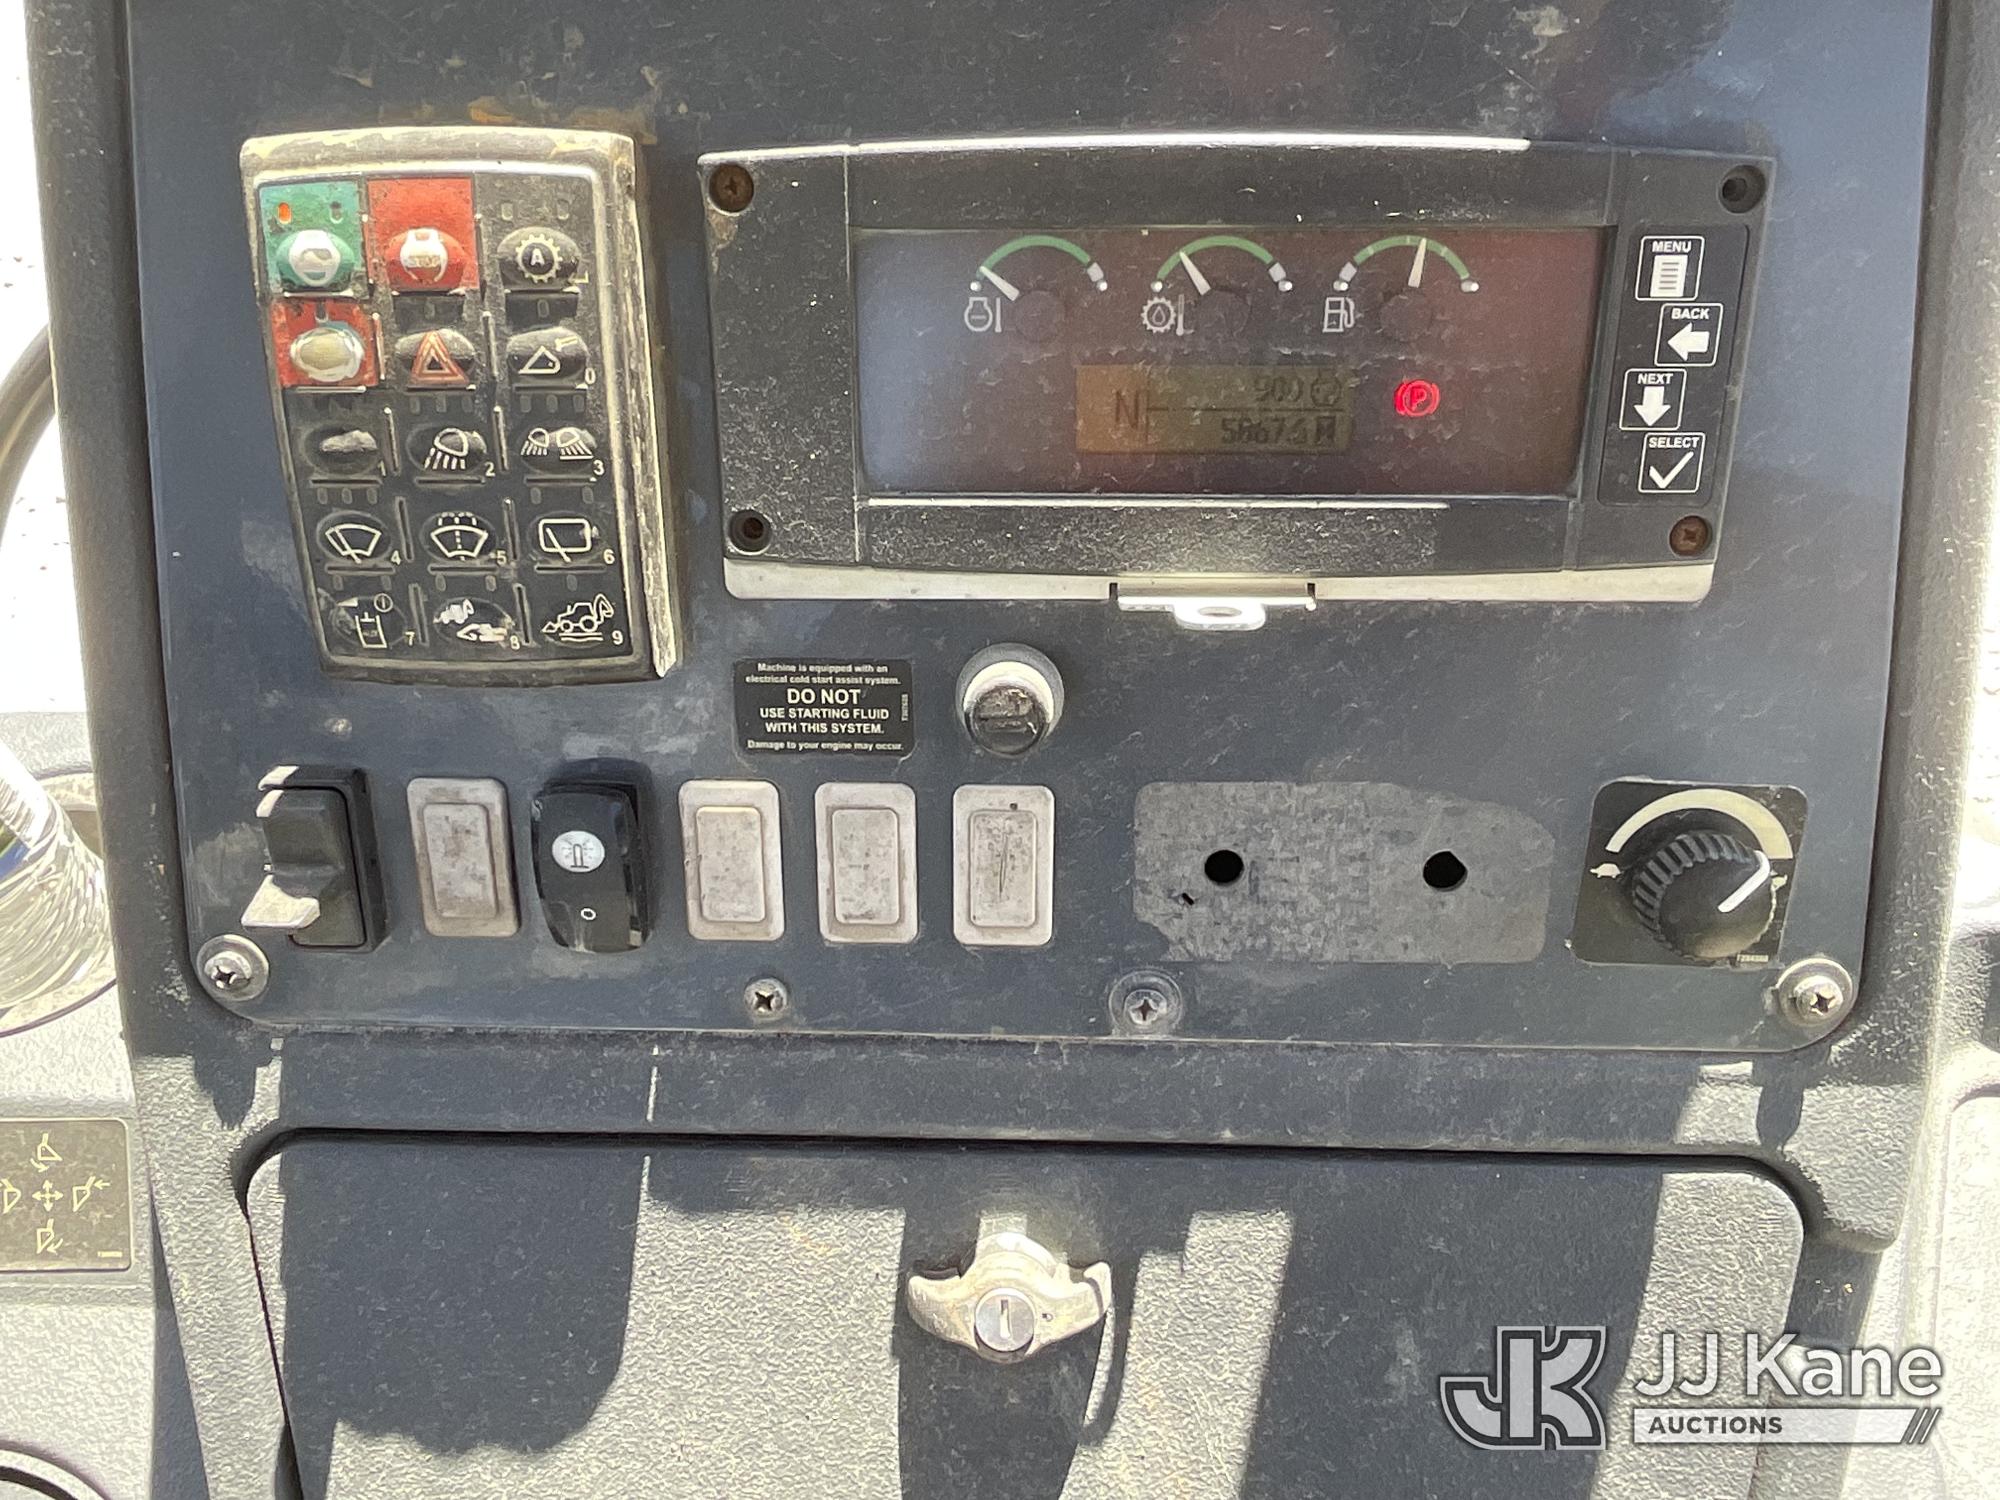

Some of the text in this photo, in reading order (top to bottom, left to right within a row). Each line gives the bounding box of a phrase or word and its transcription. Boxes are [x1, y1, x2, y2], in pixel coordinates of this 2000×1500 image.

[1652, 241, 1691, 252] MENU
[1671, 308, 1709, 319] BACK
[1637, 373, 1673, 384] NEXT
[1649, 437, 1699, 448] SELECT
[378, 462, 387, 477] 1
[484, 462, 495, 477] 2
[594, 459, 605, 475] 3
[391, 551, 401, 565] 4
[496, 550, 507, 565] 5
[604, 550, 615, 565] 6
[405, 631, 416, 646] 7
[509, 635, 520, 650] 8
[612, 630, 623, 645] 9
[757, 663, 796, 672] Machine
[799, 664, 807, 672] is
[809, 664, 852, 673] equipped
[746, 675, 787, 683] electrical
[812, 676, 833, 684] start
[836, 676, 862, 684] assist
[865, 677, 901, 685] system.
[787, 688, 861, 704] DO NOT
[760, 708, 889, 719] USE STARTING FLUID
[765, 722, 884, 734] WITH THIS SYSTEM.
[747, 740, 785, 750] Damage
[821, 742, 852, 751] engine
[854, 743, 874, 751] may
